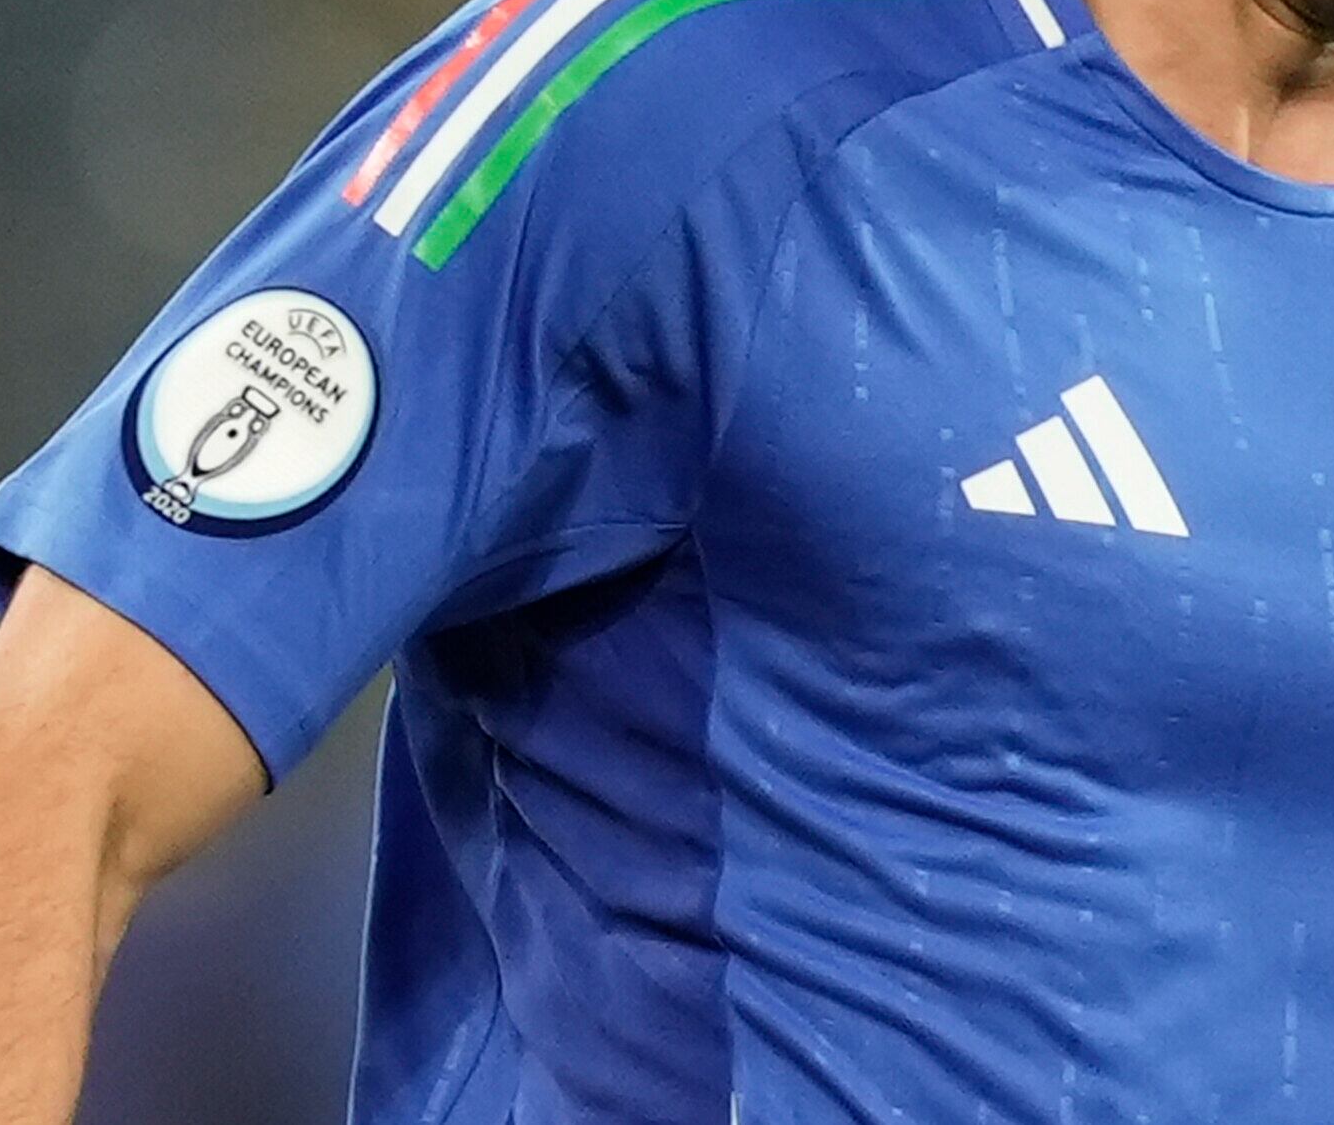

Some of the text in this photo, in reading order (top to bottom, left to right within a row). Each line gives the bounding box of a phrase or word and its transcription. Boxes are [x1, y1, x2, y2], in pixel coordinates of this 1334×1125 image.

[241, 319, 347, 404] EUROPEAN
[288, 312, 340, 357] UEFA
[225, 341, 329, 424] CHAMPIONS
[143, 486, 190, 524] 2020
